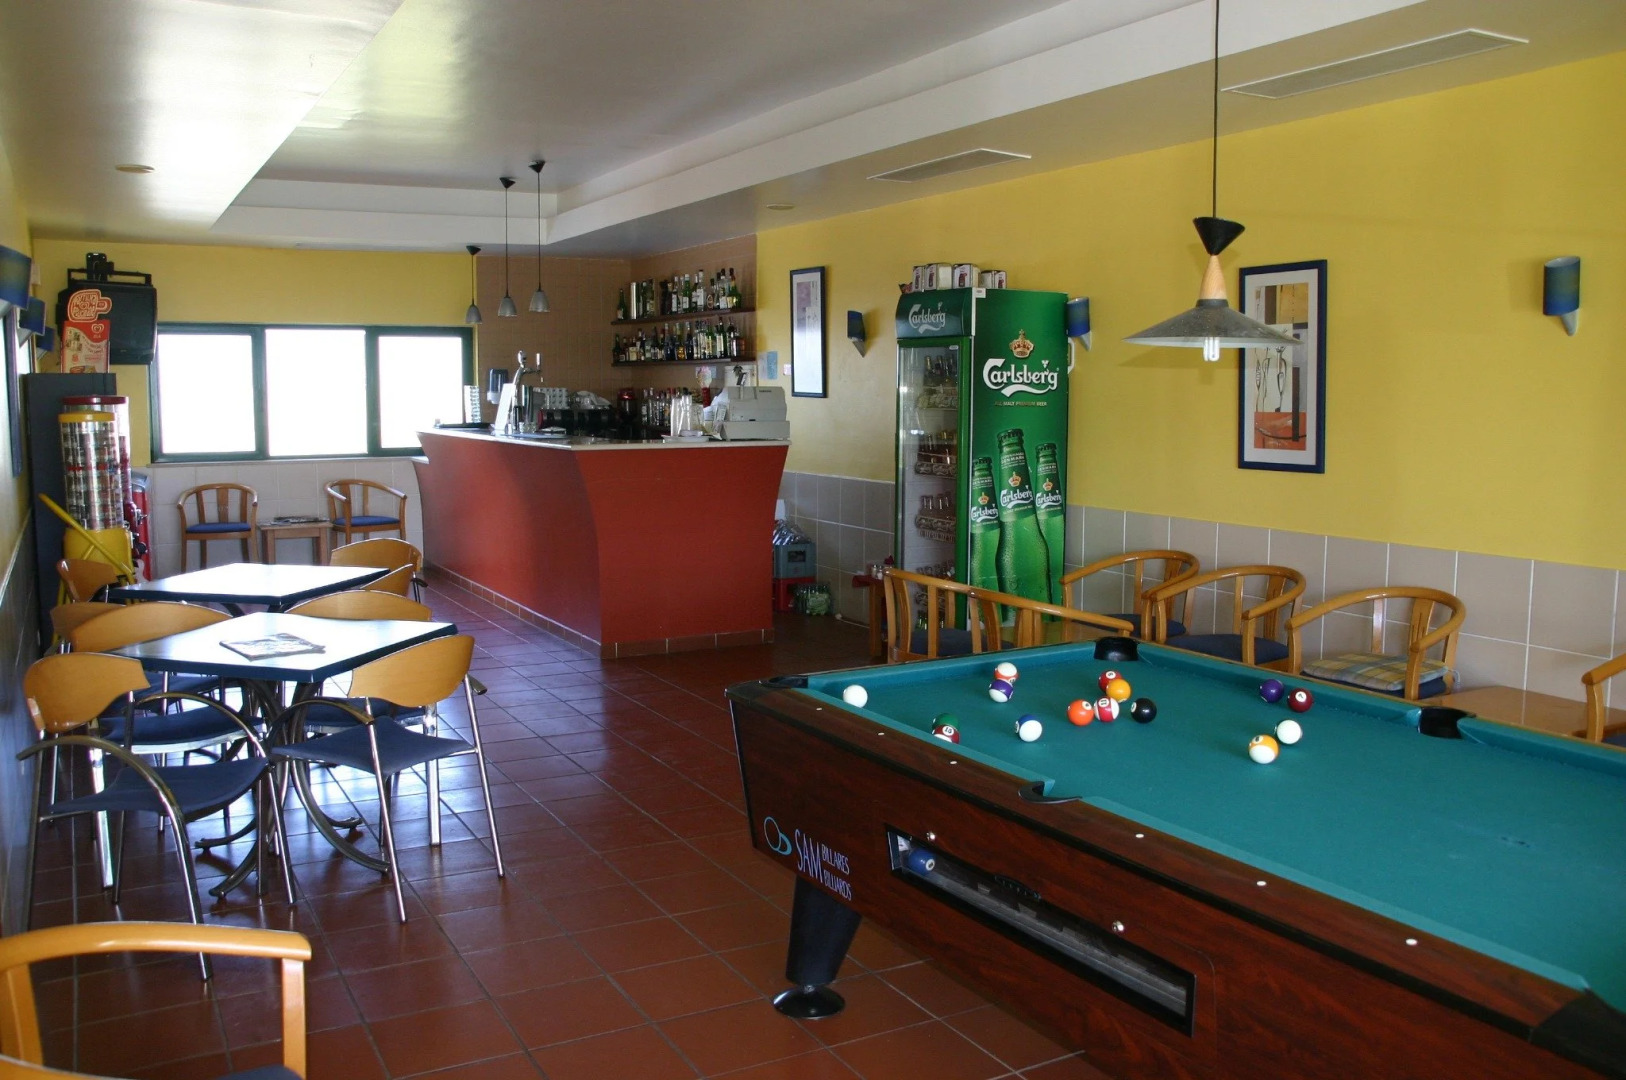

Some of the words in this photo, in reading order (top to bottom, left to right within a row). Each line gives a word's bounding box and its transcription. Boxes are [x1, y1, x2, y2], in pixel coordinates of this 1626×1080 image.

[908, 302, 946, 333] Carlsberg
[983, 358, 1058, 395] Carlsberg
[971, 505, 998, 521] Carlsberg
[1000, 488, 1033, 507] Carlsberg
[1035, 492, 1062, 507] Carlsberg
[795, 828, 823, 884] SAM
[821, 843, 850, 875] BILLARES
[823, 869, 852, 901] BILLIARDS
